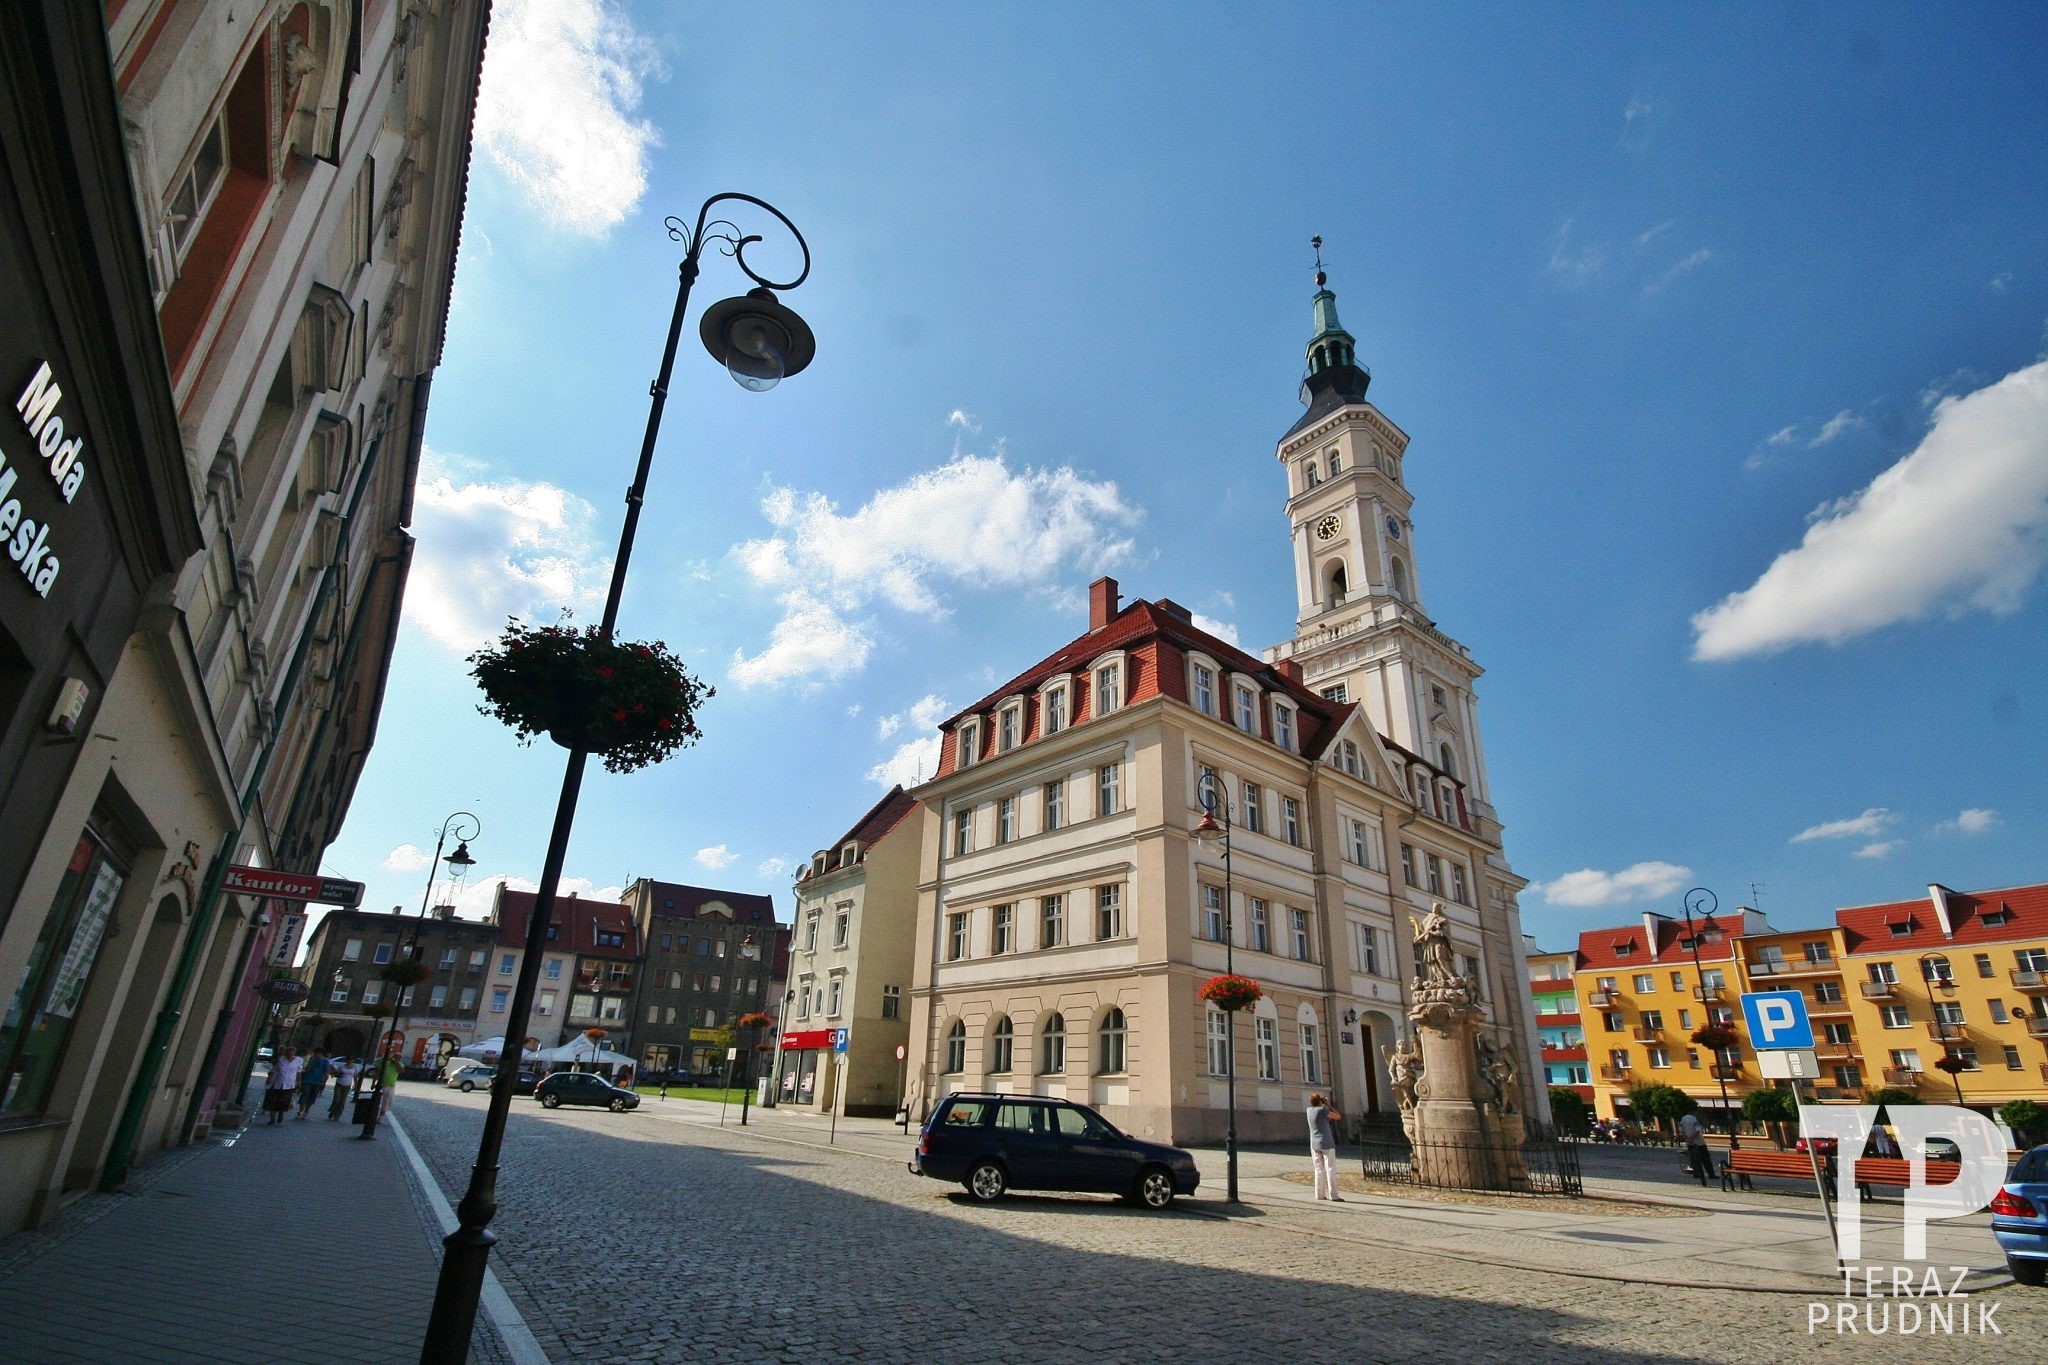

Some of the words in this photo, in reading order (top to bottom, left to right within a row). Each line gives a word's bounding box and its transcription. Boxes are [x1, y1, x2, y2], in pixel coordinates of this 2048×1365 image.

[17, 361, 84, 504] Moda
[225, 872, 312, 894] Kantor
[1755, 998, 1795, 1041] P
[836, 1030, 845, 1049] P
